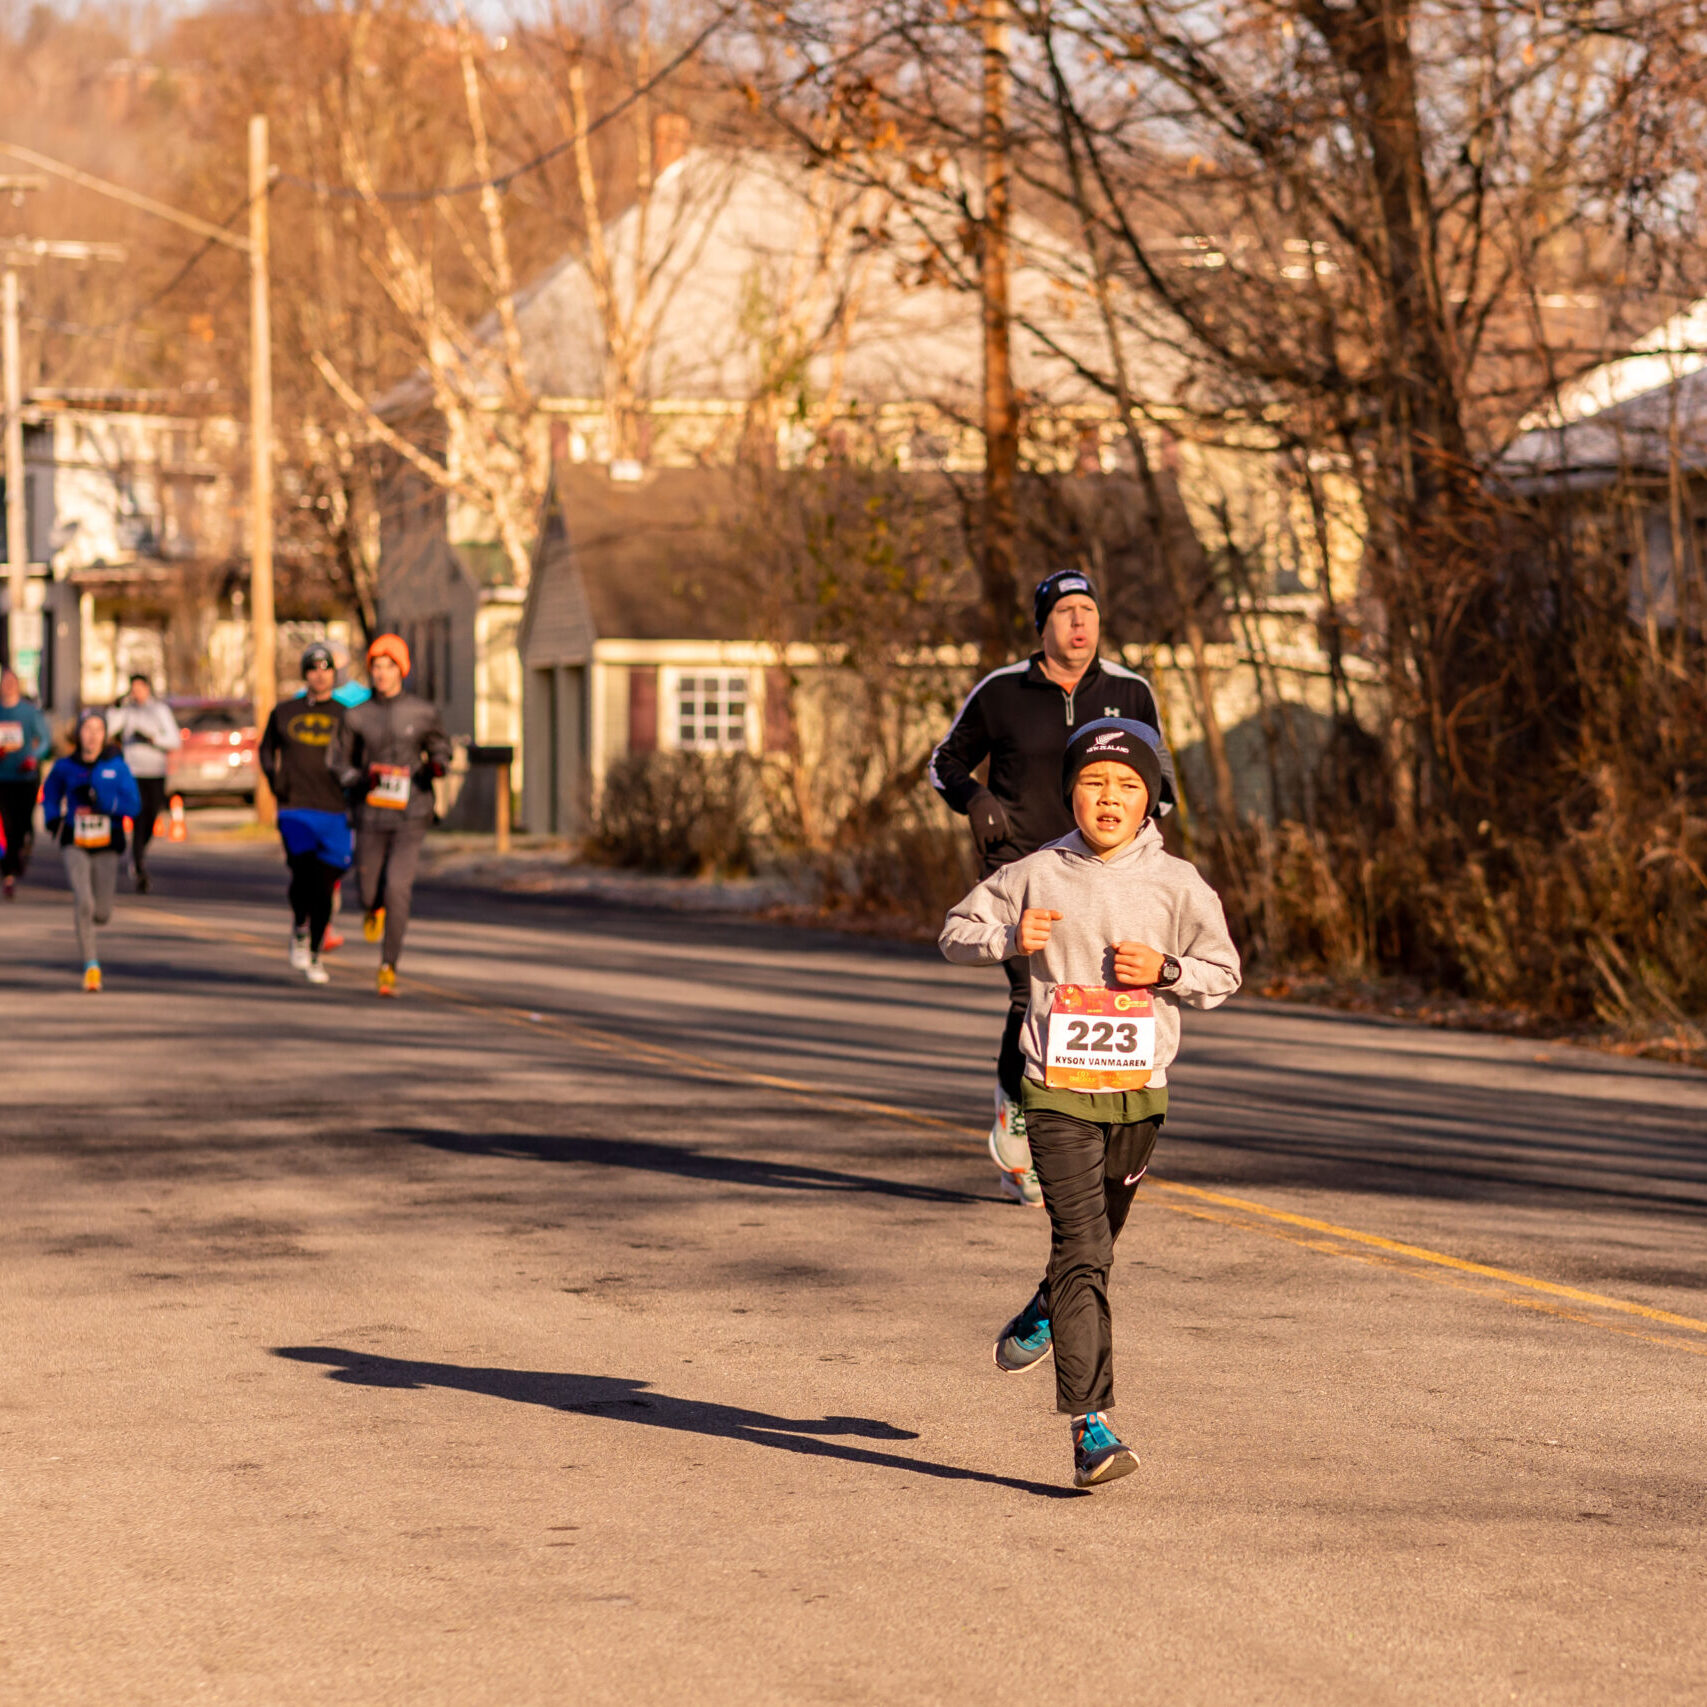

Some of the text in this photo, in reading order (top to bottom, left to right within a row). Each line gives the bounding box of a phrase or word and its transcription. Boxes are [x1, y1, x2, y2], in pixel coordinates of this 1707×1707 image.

[1099, 745, 1129, 753] ZEALAND
[1066, 1020, 1138, 1053] 223
[1055, 1055, 1146, 1066] KYSON VANMAAREN
